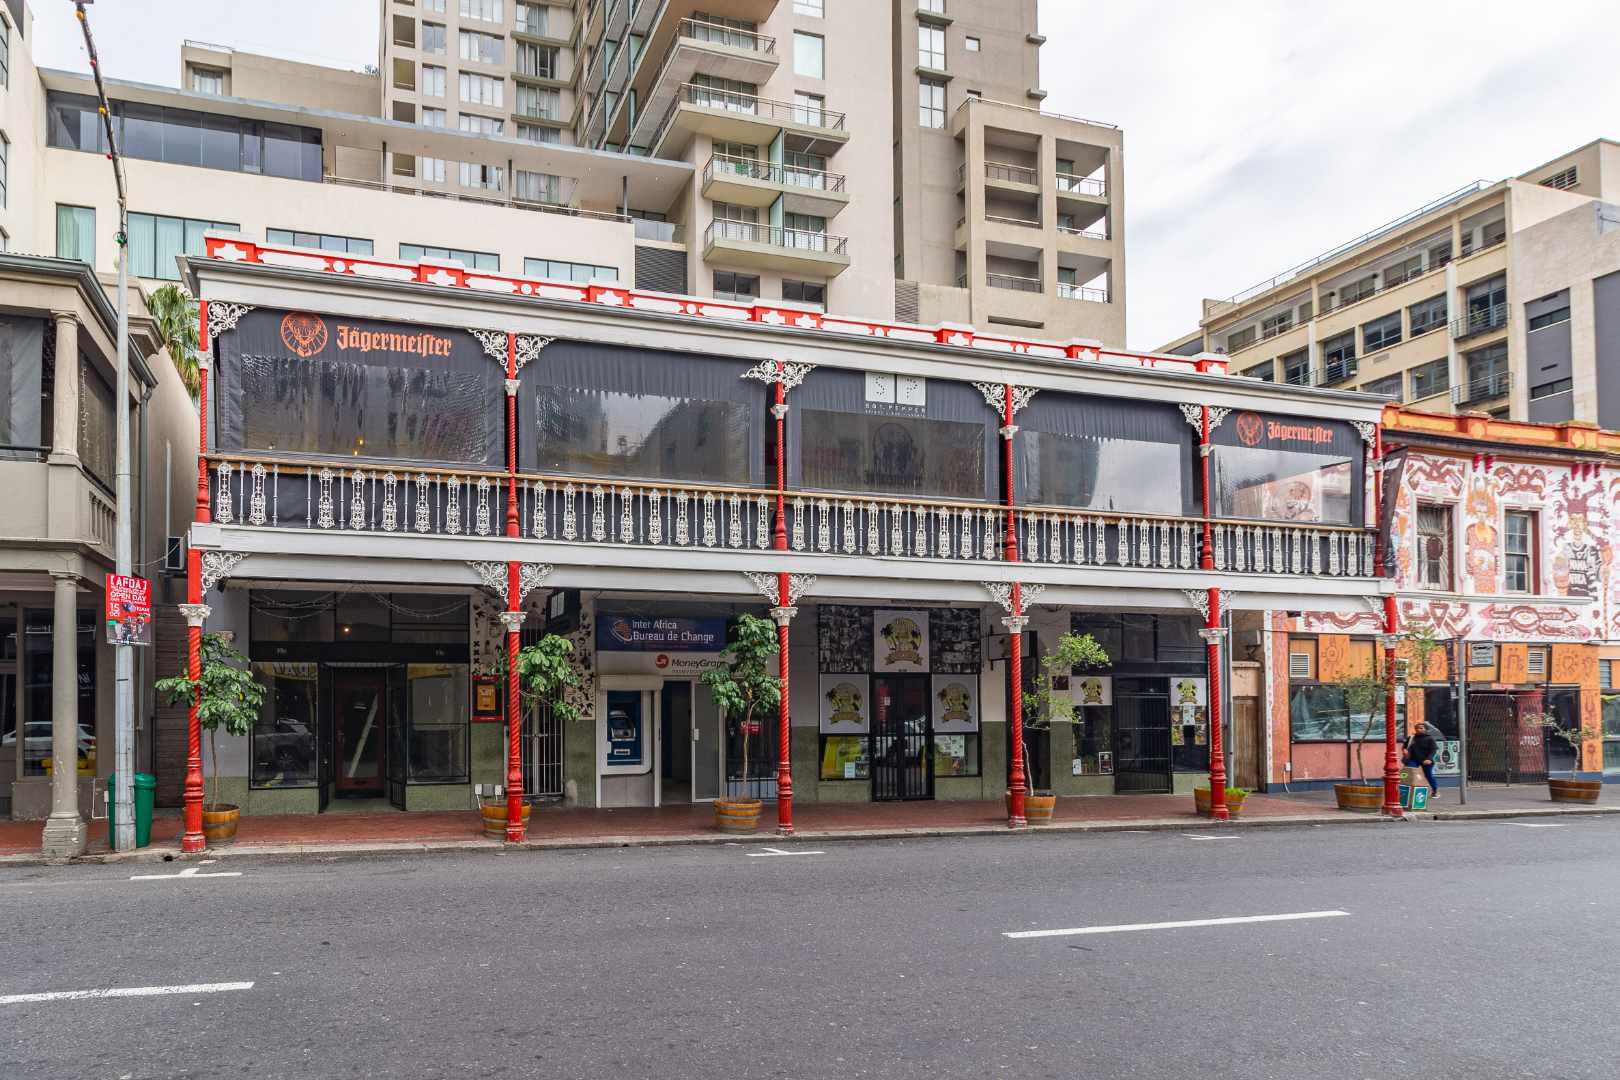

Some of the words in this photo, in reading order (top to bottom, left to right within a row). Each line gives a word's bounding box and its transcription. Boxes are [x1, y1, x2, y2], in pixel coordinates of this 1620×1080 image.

[110, 591, 131, 599] OPEN
[110, 602, 120, 612] 15
[632, 620, 651, 629] Inter
[653, 620, 678, 629] Africa
[633, 631, 665, 641] Bureau
[667, 631, 678, 641] de
[681, 631, 714, 643] Change
[671, 658, 721, 669] MoneyGra
